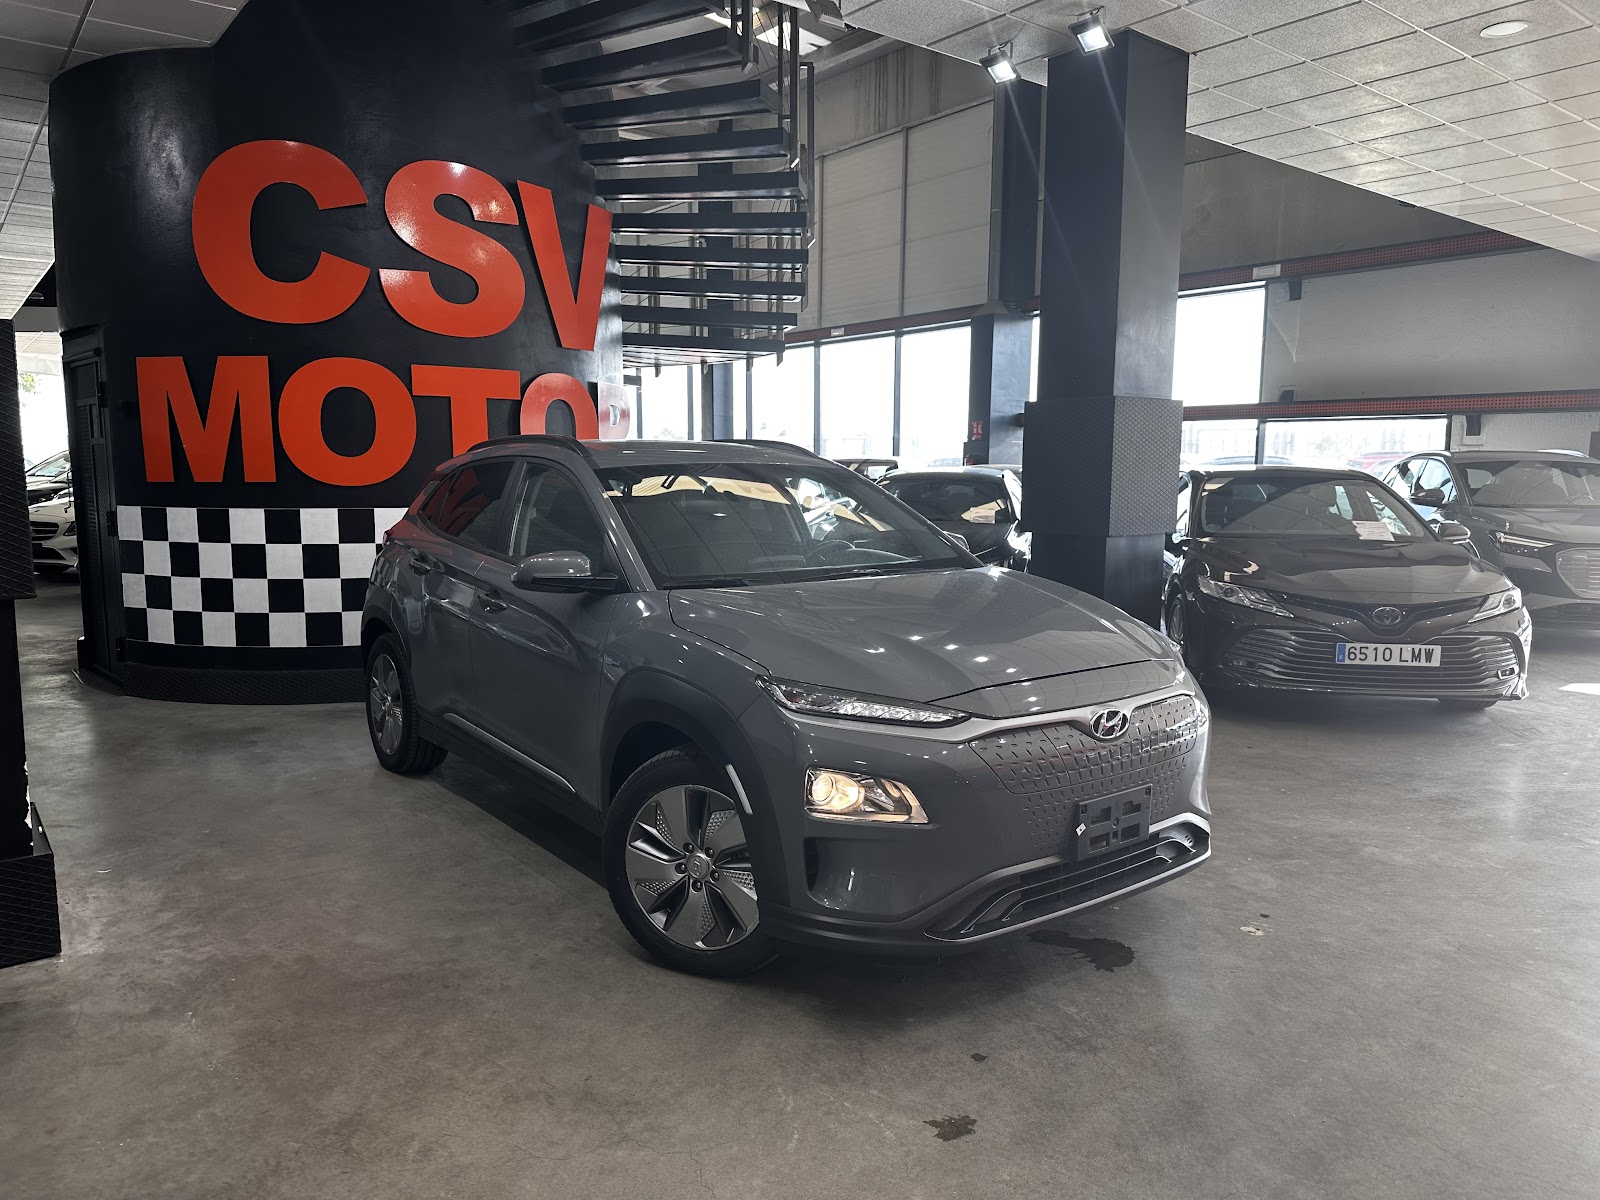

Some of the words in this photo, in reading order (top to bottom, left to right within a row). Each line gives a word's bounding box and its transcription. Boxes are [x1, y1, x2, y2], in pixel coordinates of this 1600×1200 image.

[192, 140, 612, 351] CSV
[1347, 646, 1393, 662] 6510
[1399, 647, 1434, 663] LMW
